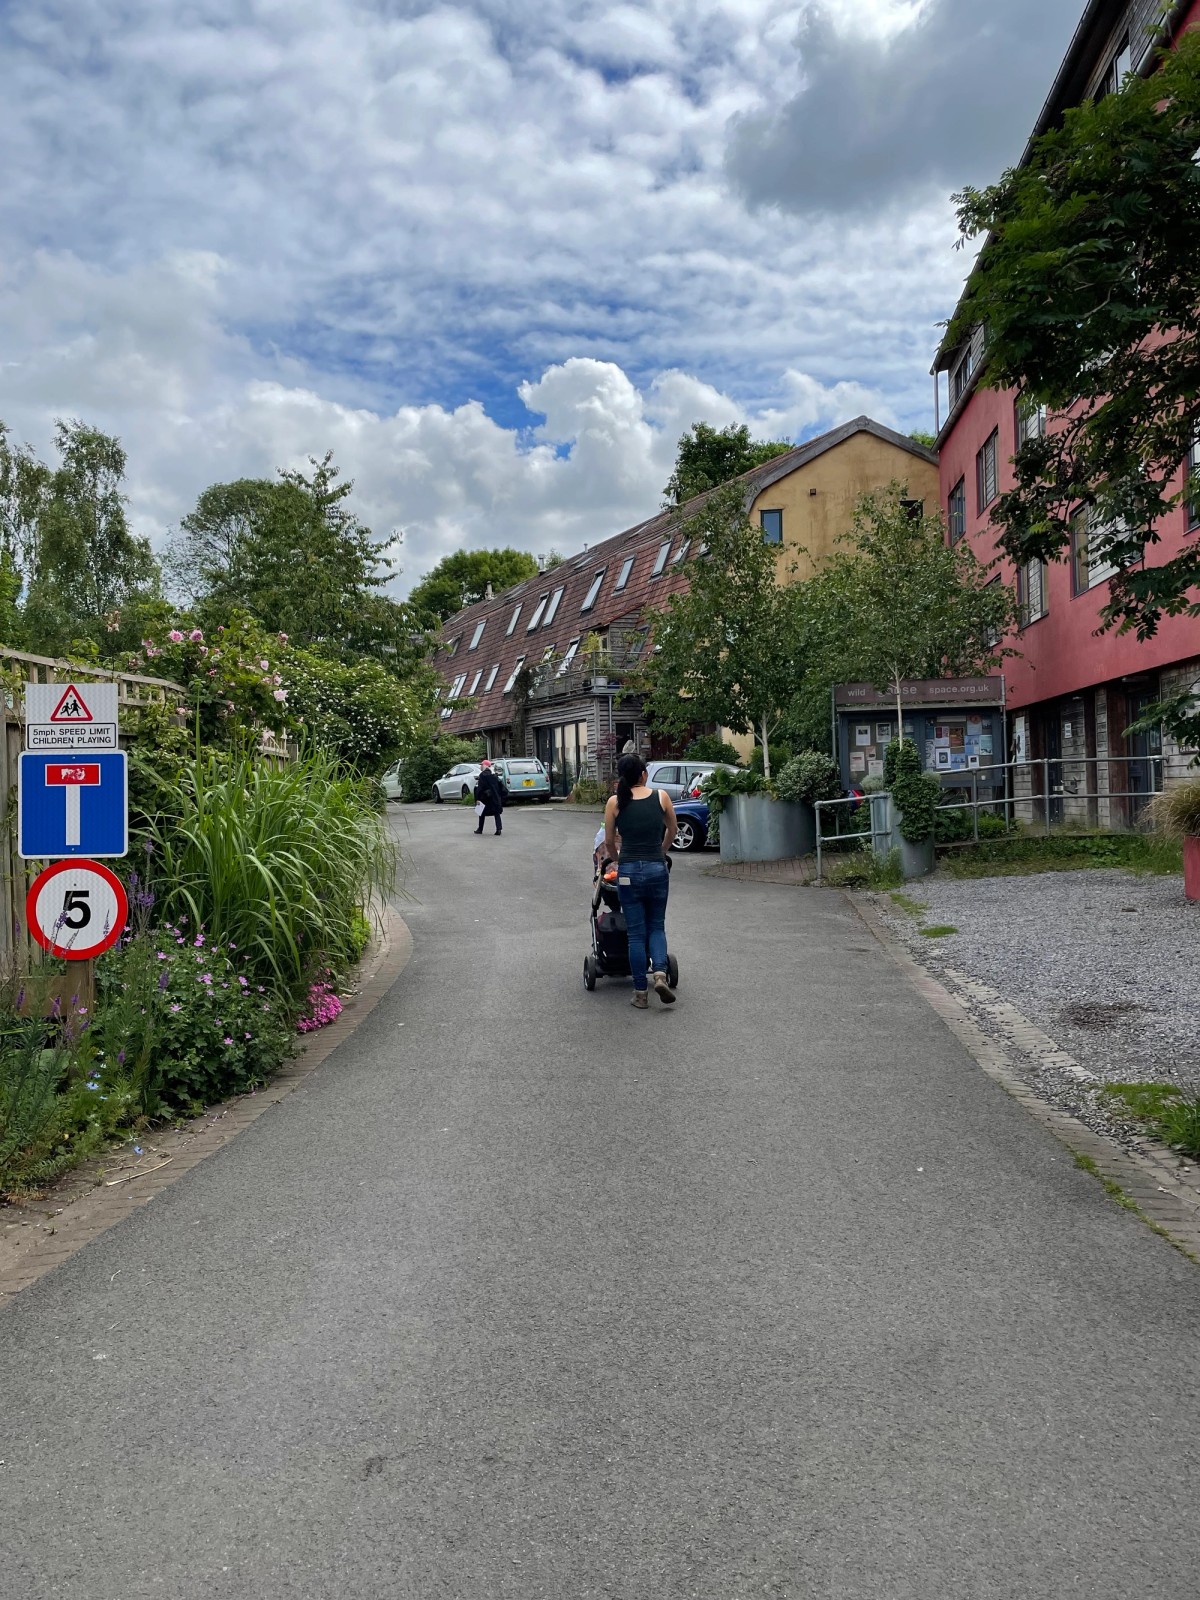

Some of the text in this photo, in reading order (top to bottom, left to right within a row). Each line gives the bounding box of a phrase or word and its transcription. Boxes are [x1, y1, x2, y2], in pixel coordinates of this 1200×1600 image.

[847, 688, 866, 697] wild
[929, 684, 990, 695] space.org.uk
[33, 727, 111, 737] 5mph SPEED LIMIT
[32, 736, 112, 745] CHILDREN PLAYING
[62, 890, 91, 930] 5
